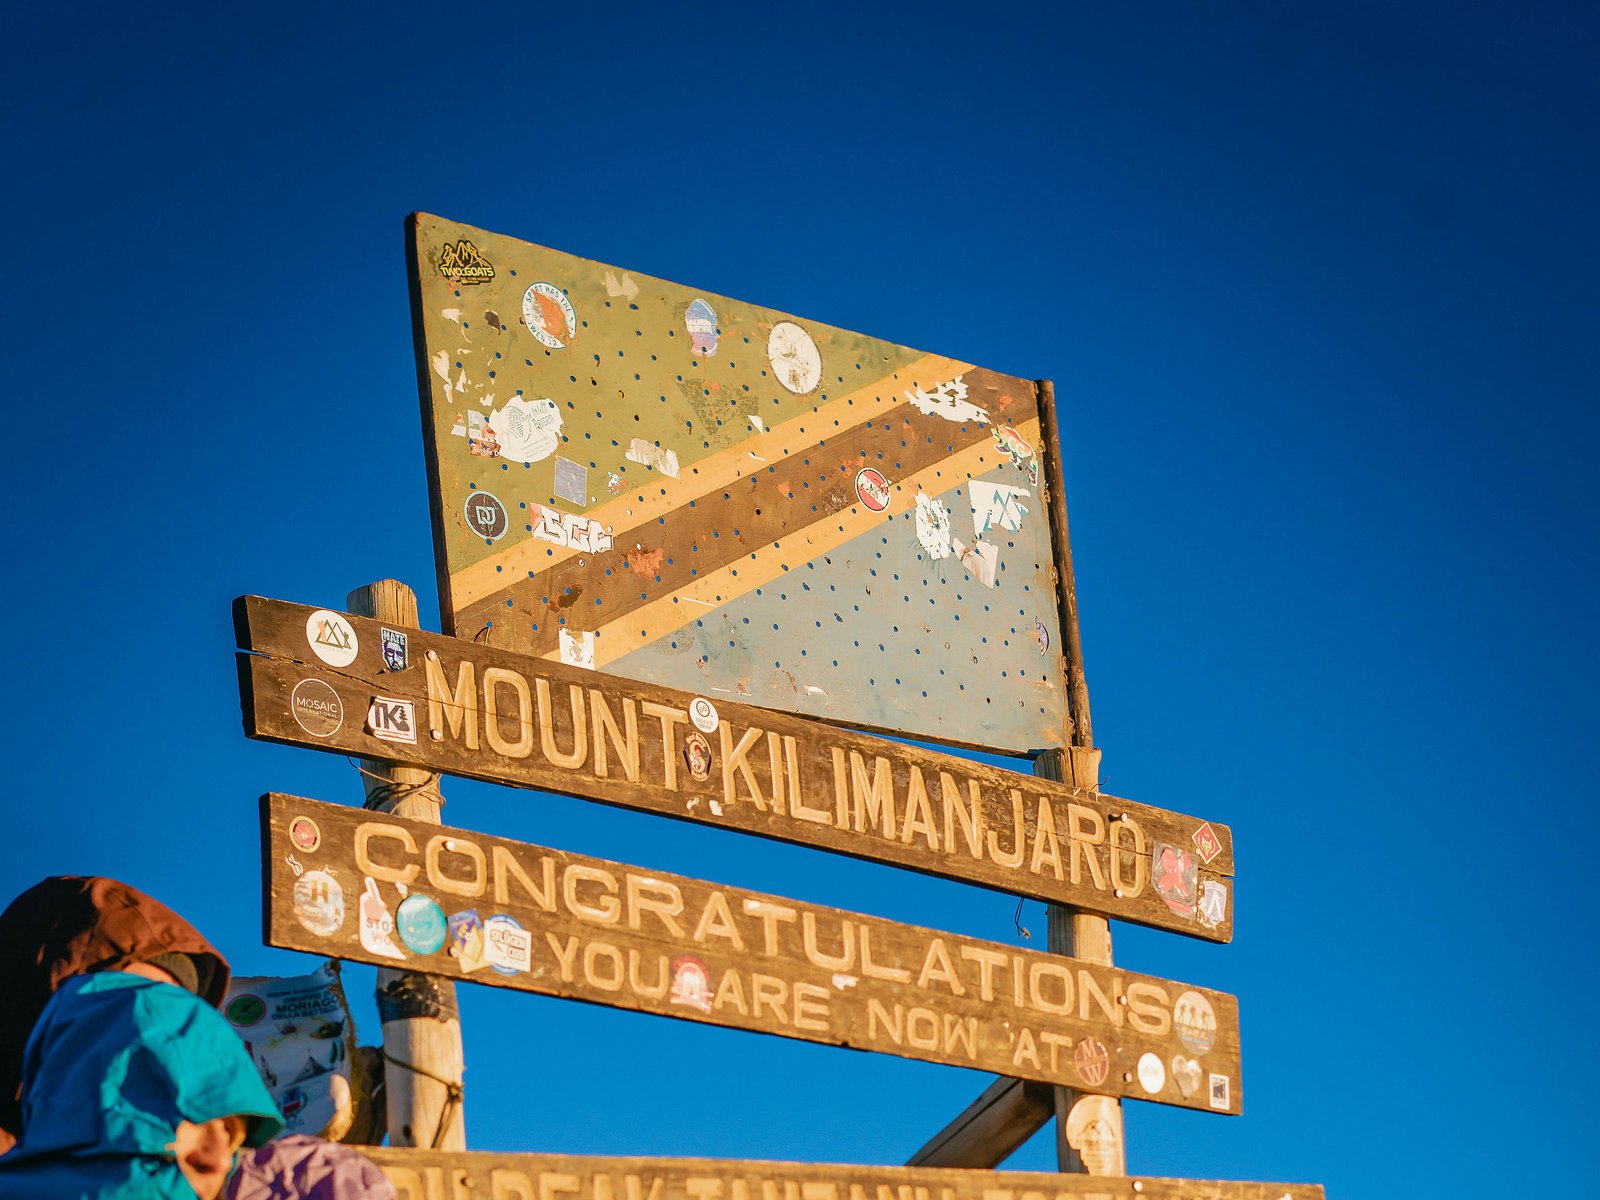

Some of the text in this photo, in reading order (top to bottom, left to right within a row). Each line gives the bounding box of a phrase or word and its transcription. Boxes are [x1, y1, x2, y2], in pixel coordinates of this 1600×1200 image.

[296, 696, 338, 713] MOSAIC
[296, 706, 339, 719] INTERNATIONAL
[425, 650, 1148, 899] MOUNT KILIMANJARO
[354, 821, 1172, 1036] CONGRATULATIONS
[366, 917, 393, 932] STO
[275, 994, 339, 1013] MORIAGO
[545, 931, 670, 1001] YOU
[713, 967, 830, 1031] ARE
[867, 1002, 978, 1061] NOW
[1012, 1027, 1073, 1073] AT
